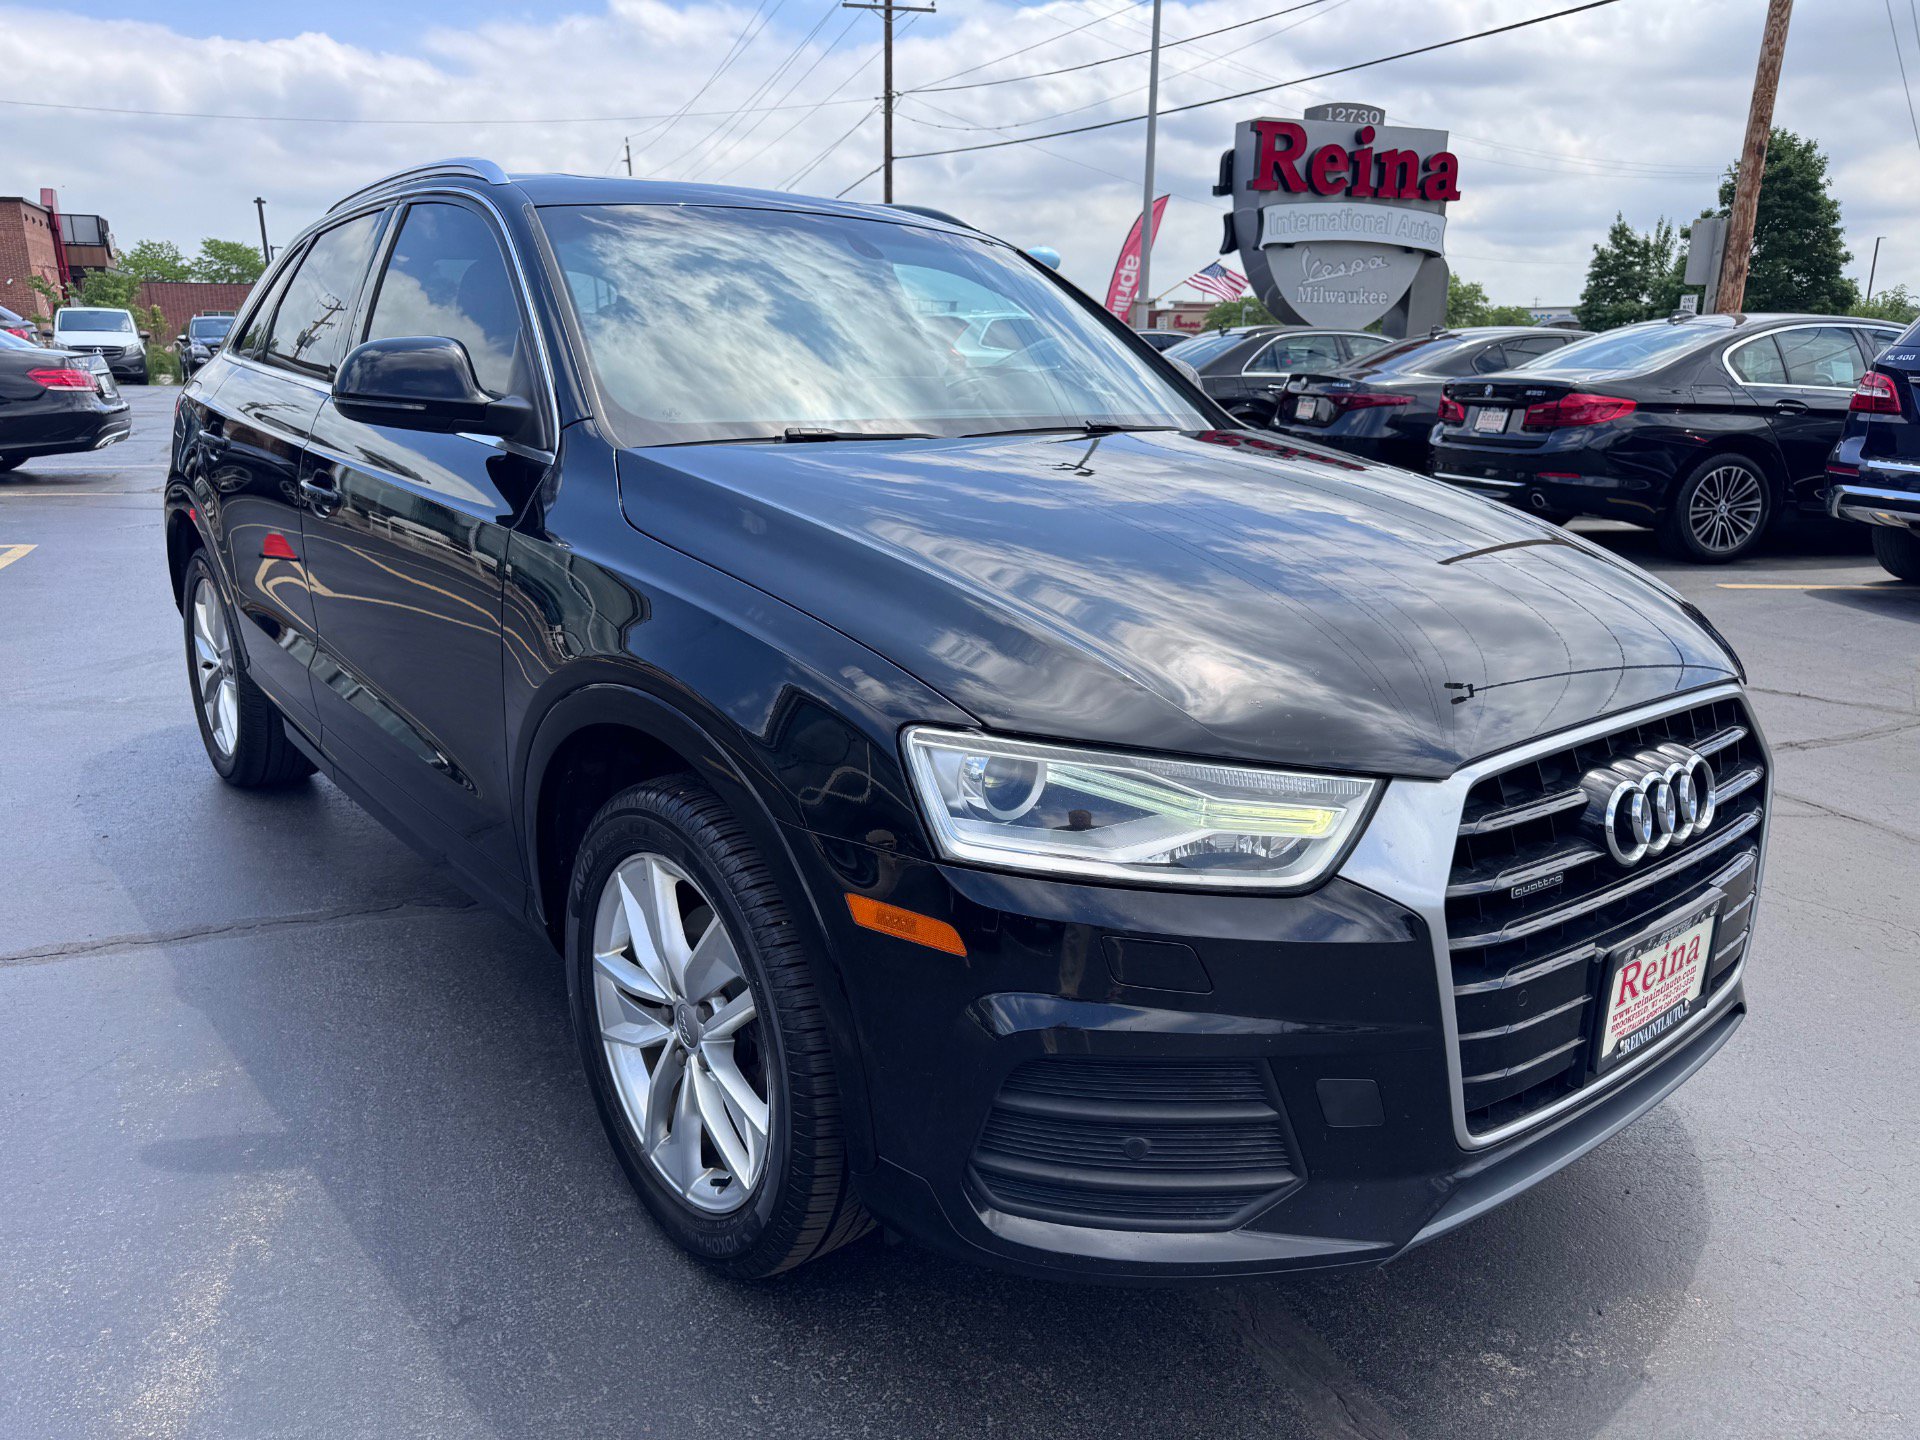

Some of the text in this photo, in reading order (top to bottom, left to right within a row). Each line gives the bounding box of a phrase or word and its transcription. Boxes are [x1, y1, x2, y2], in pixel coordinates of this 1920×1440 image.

[1325, 107, 1381, 124] 12730
[1247, 121, 1461, 201] Reina
[1269, 206, 1440, 244] International Auto
[1301, 246, 1390, 284] Vespa
[1297, 286, 1388, 305] Milwaukee
[1683, 296, 1696, 304] ONE
[1514, 873, 1562, 897] quattro
[1615, 935, 1701, 1008] Reina
